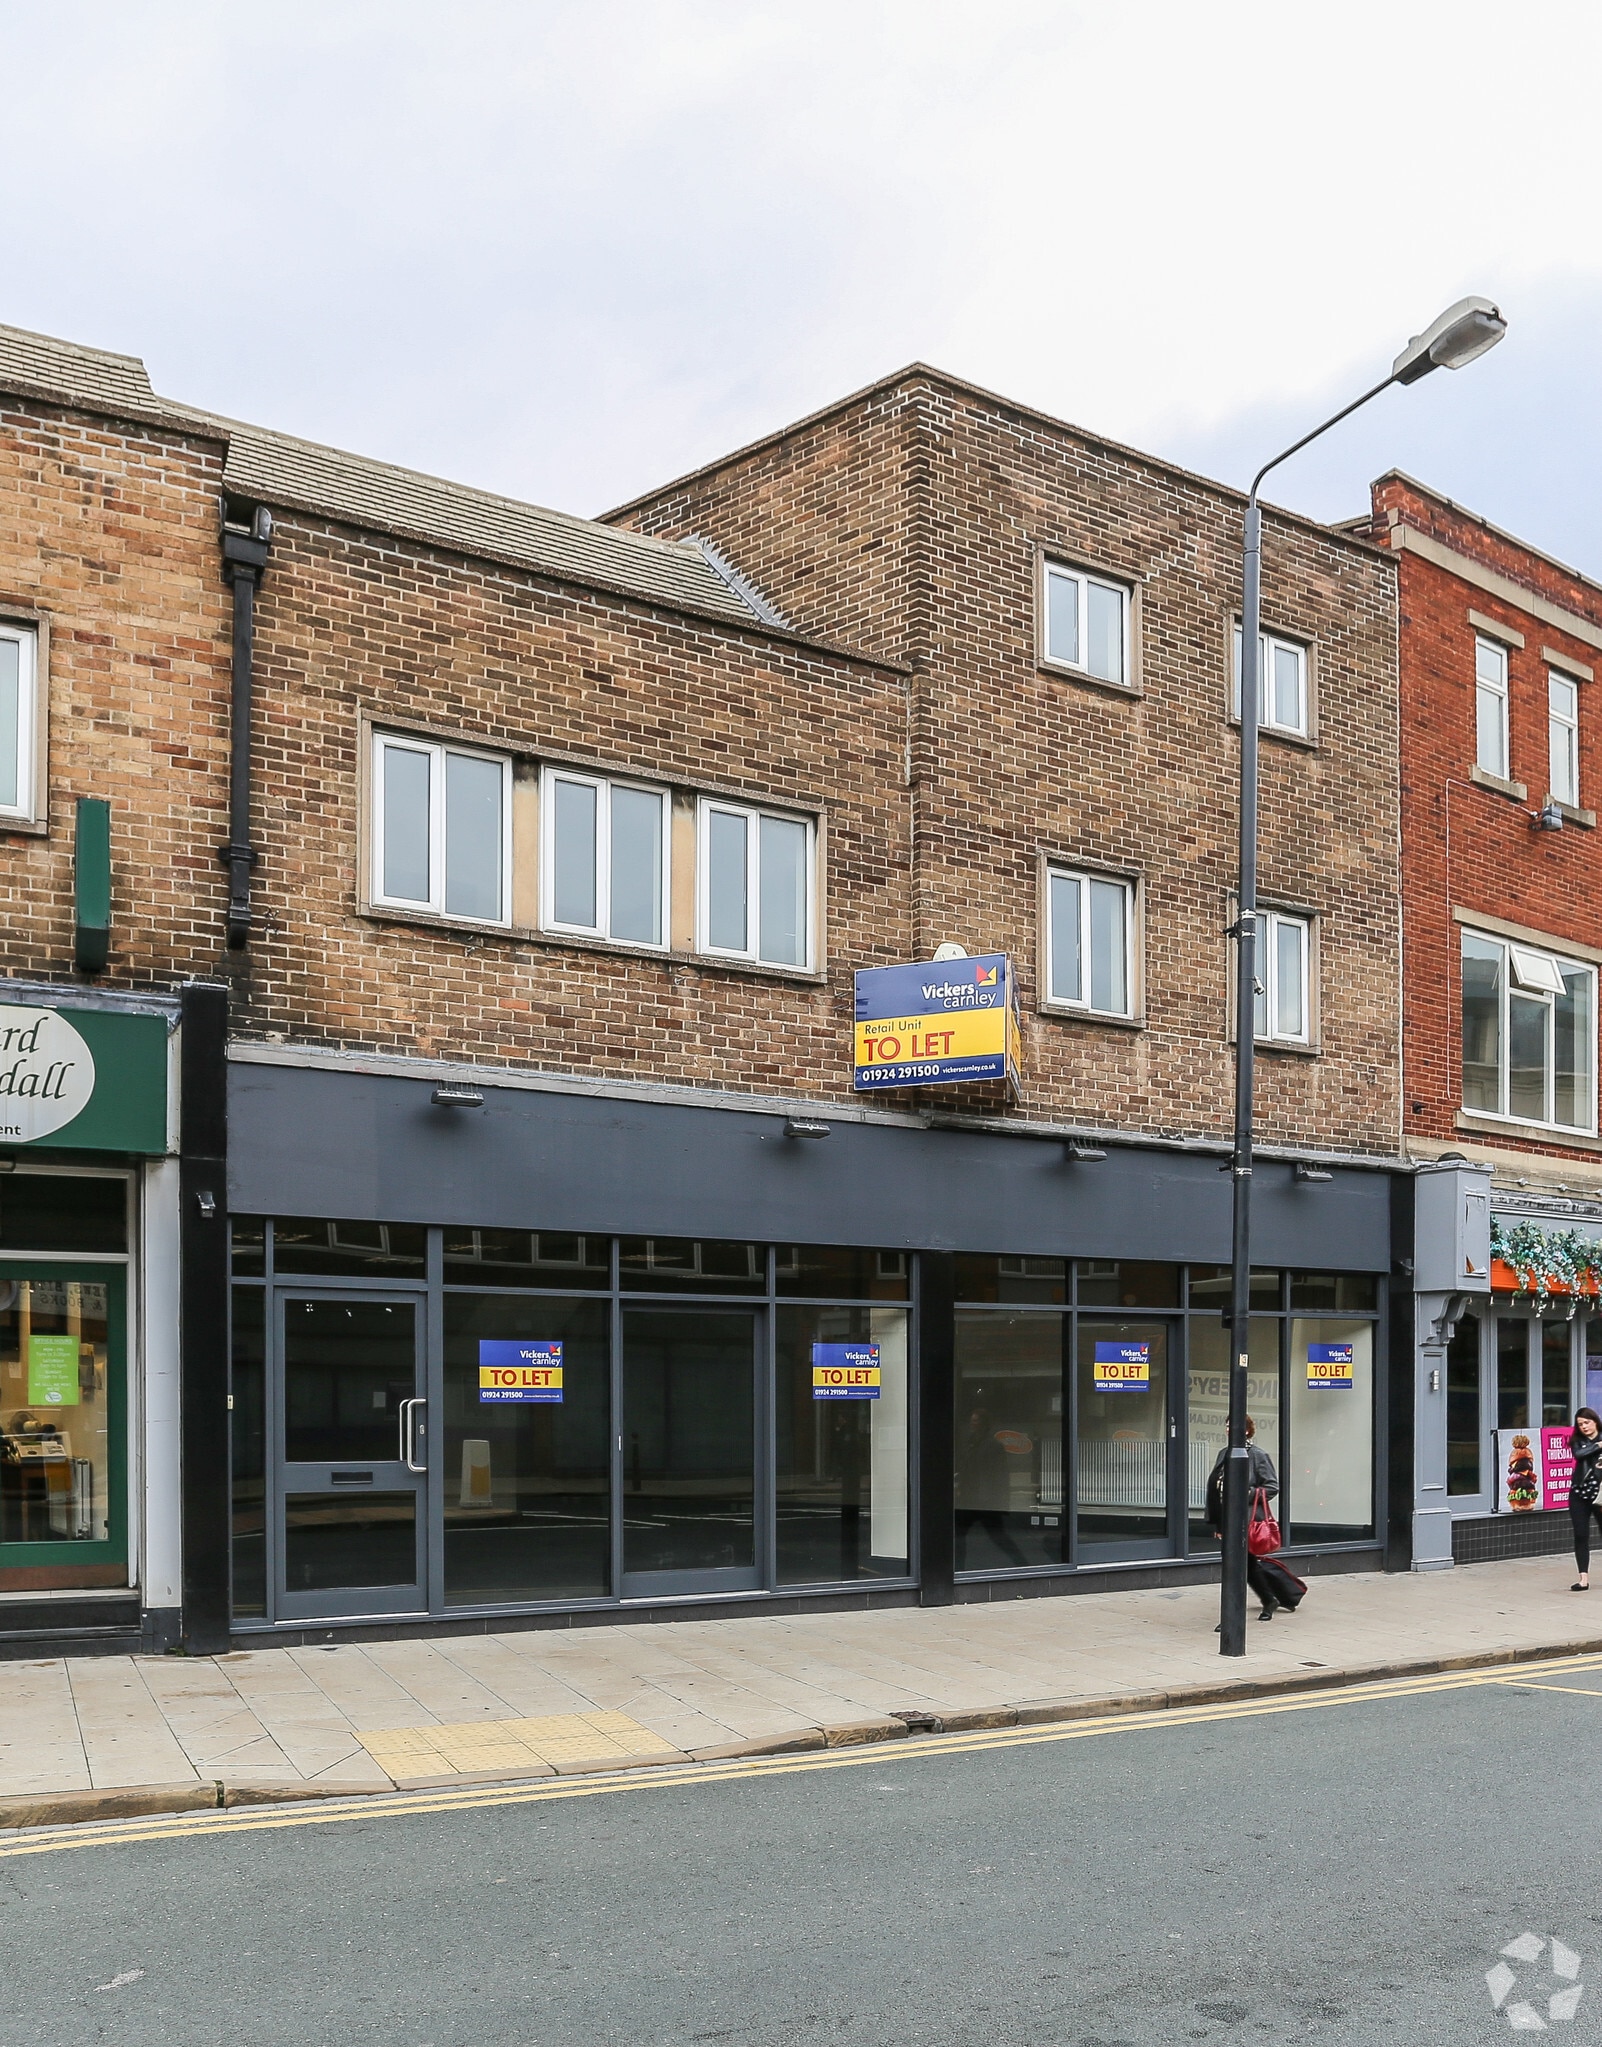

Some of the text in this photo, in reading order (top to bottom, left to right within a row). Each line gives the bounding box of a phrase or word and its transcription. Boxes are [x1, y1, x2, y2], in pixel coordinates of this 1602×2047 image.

[921, 982, 975, 999] Vickers
[943, 990, 997, 1008] carnley
[865, 1019, 922, 1035] Retail Unit
[0, 1016, 49, 1053] rd
[863, 1031, 955, 1061] TO LET
[862, 1066, 896, 1081] 01924
[898, 1064, 940, 1079] 291500
[520, 1350, 549, 1359] Vickers
[845, 1352, 870, 1360] Vickers
[1121, 1349, 1141, 1357] Vickers
[532, 1356, 561, 1367] carnley
[490, 1370, 552, 1385] TO LET
[821, 1370, 872, 1384] TO LET
[1101, 1365, 1142, 1378] TO LET
[1313, 1365, 1347, 1376] TO LET
[1550, 1437, 1563, 1448] FREE
